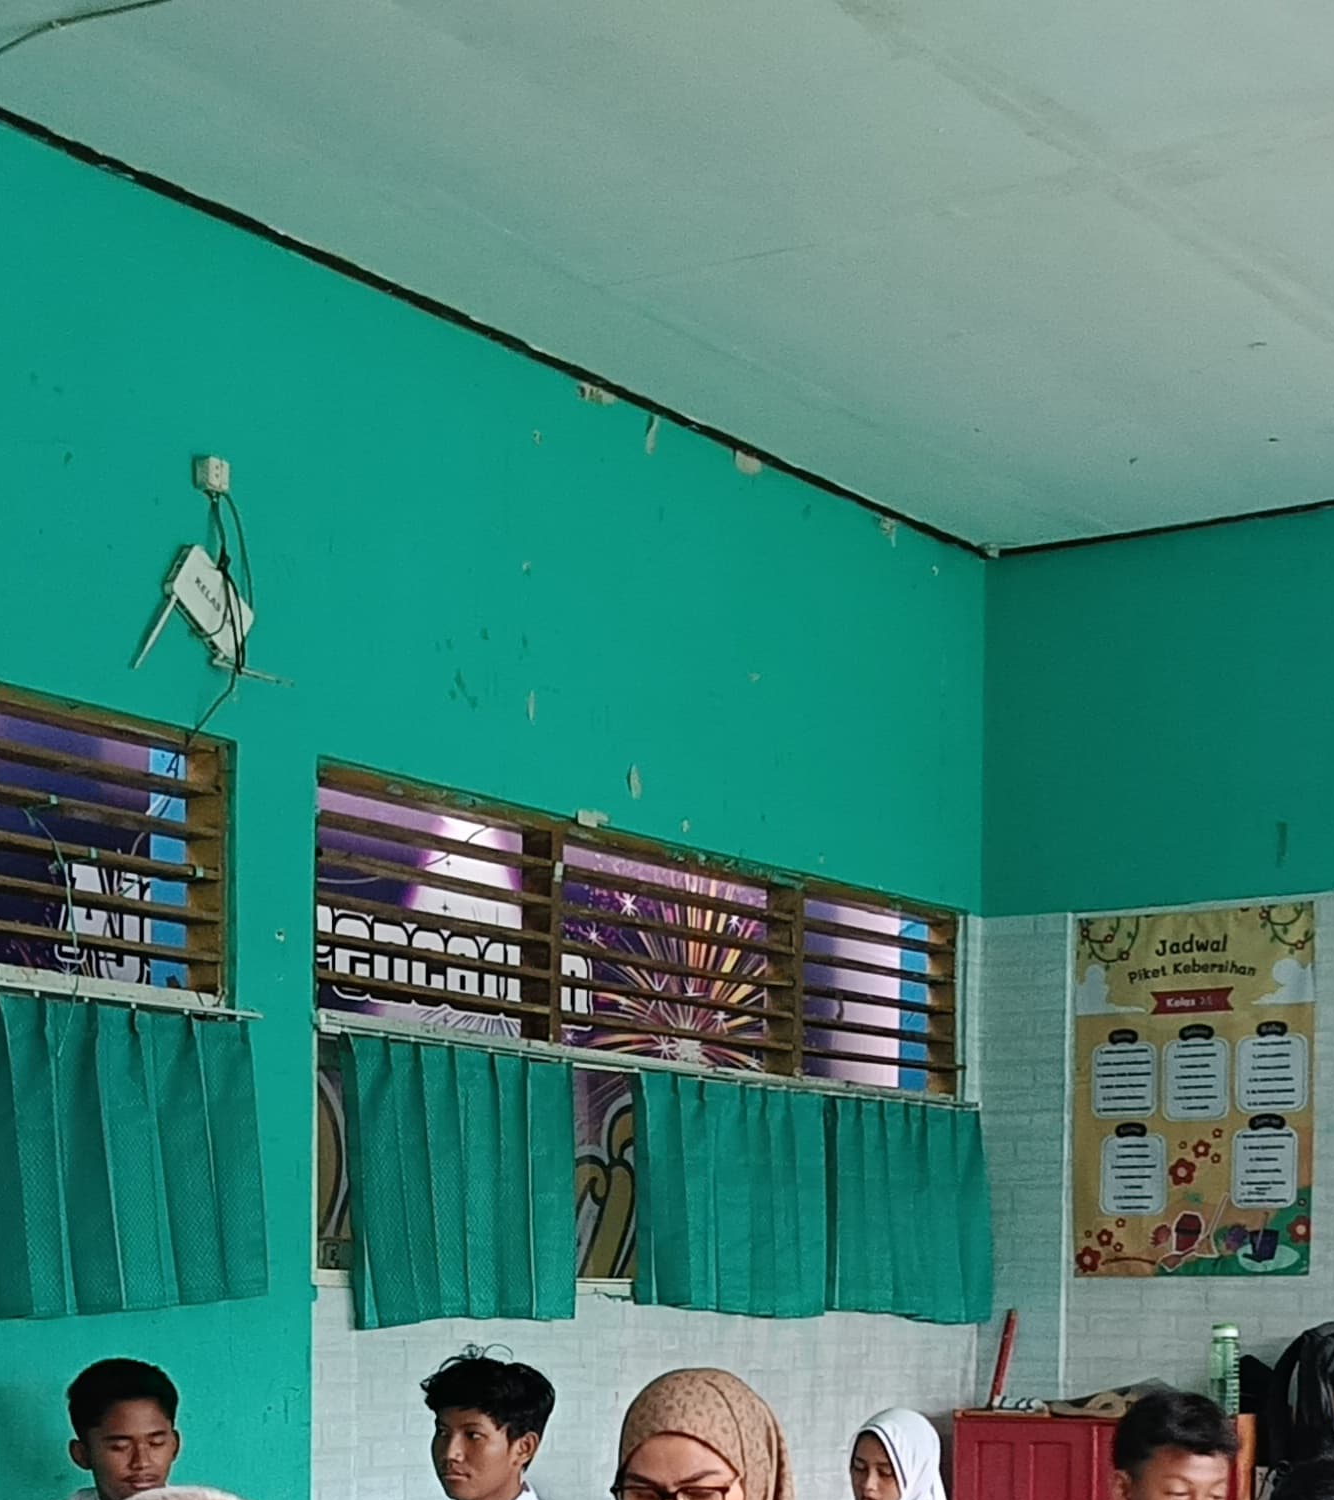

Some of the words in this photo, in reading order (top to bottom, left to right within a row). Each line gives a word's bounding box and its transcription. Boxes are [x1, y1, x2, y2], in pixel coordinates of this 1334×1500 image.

[1155, 933, 1229, 957] Jadwal
[1127, 965, 1168, 985] Piket
[1172, 957, 1257, 977] Kebersihan
